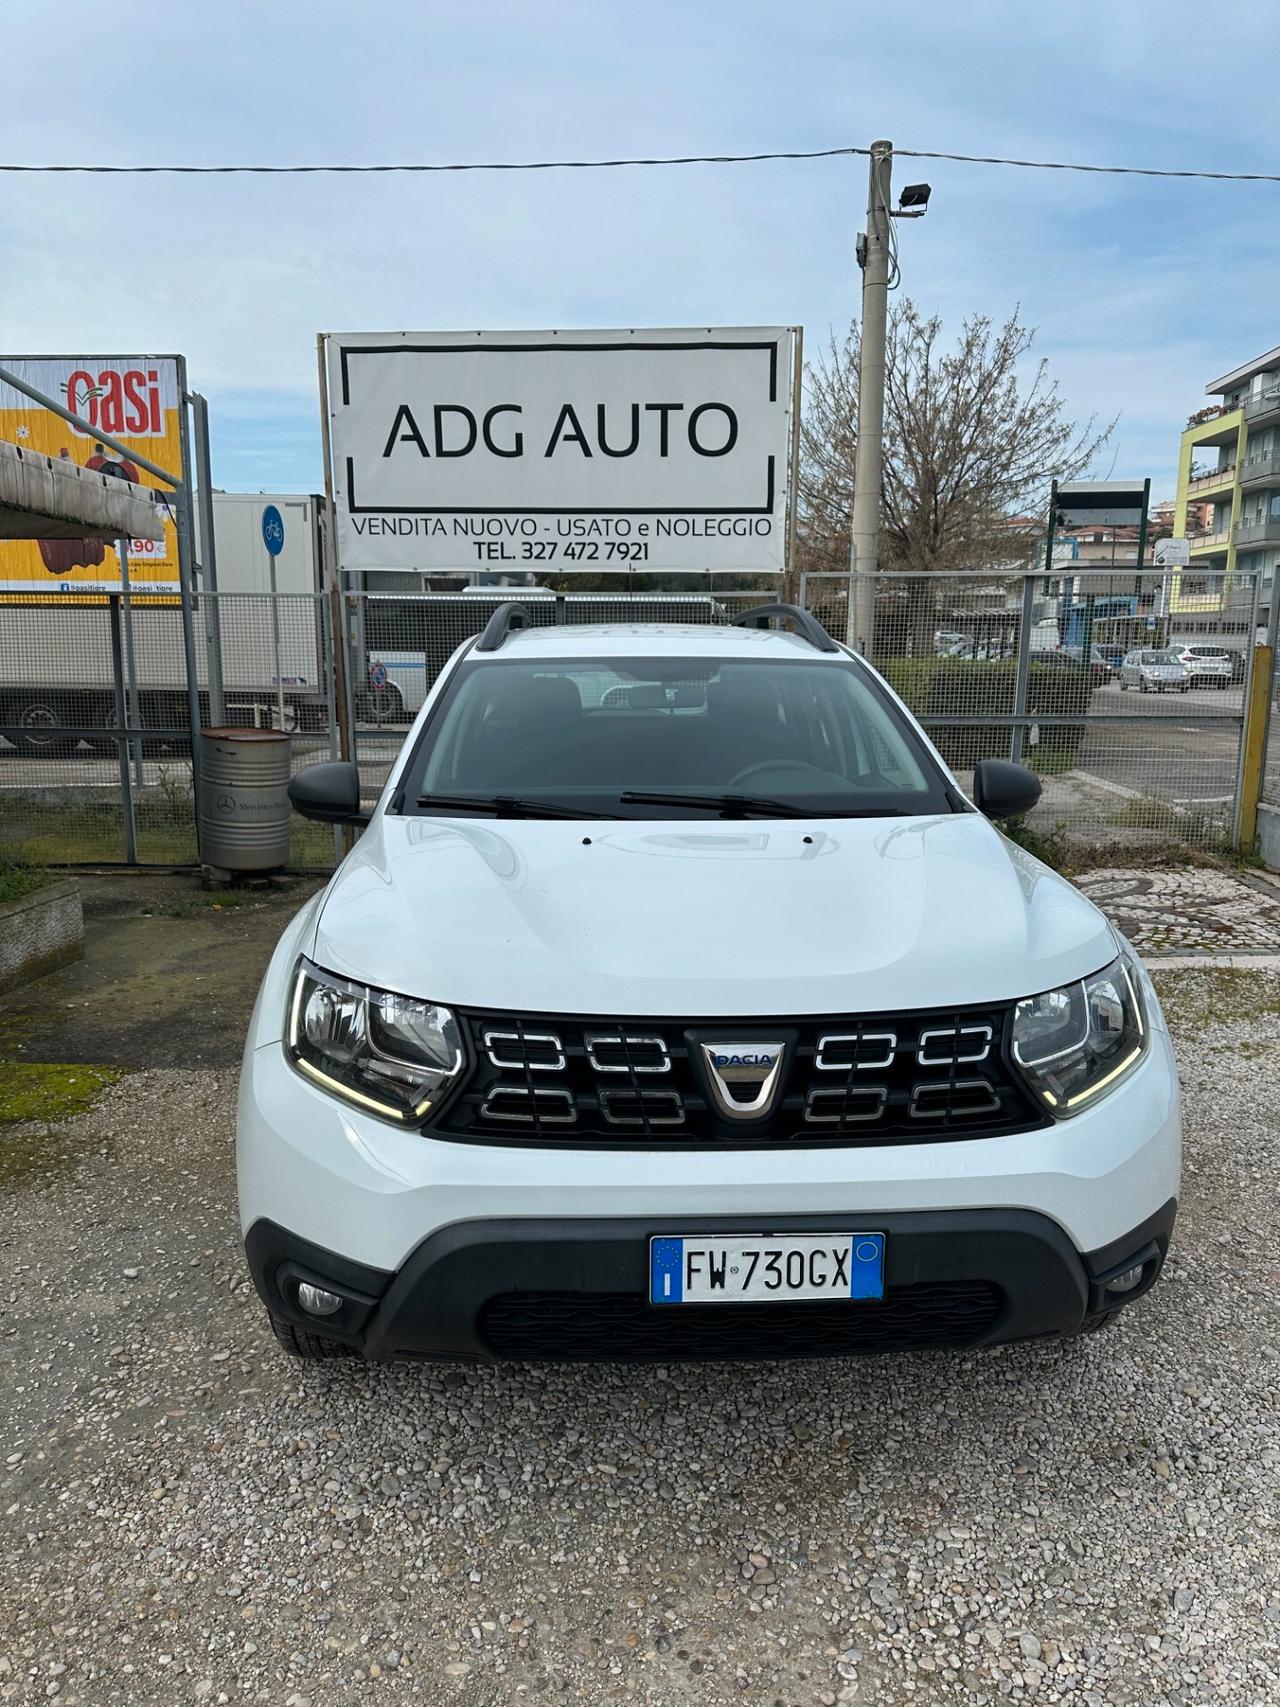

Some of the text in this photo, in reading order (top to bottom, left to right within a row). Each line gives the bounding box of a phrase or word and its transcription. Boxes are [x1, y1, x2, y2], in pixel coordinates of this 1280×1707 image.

[67, 370, 162, 433] Oasi
[382, 402, 739, 459] ADG AUTO
[351, 517, 448, 537] VENDITA
[452, 517, 538, 538] NUOVO
[556, 517, 632, 538] USATO
[637, 522, 650, 538] e
[655, 517, 773, 538] NOLEGGIO
[473, 542, 650, 561] TEL. 327 472 7921
[717, 1054, 773, 1067] DACIA
[686, 1250, 728, 1290] FW
[741, 1248, 850, 1290] 730GX
